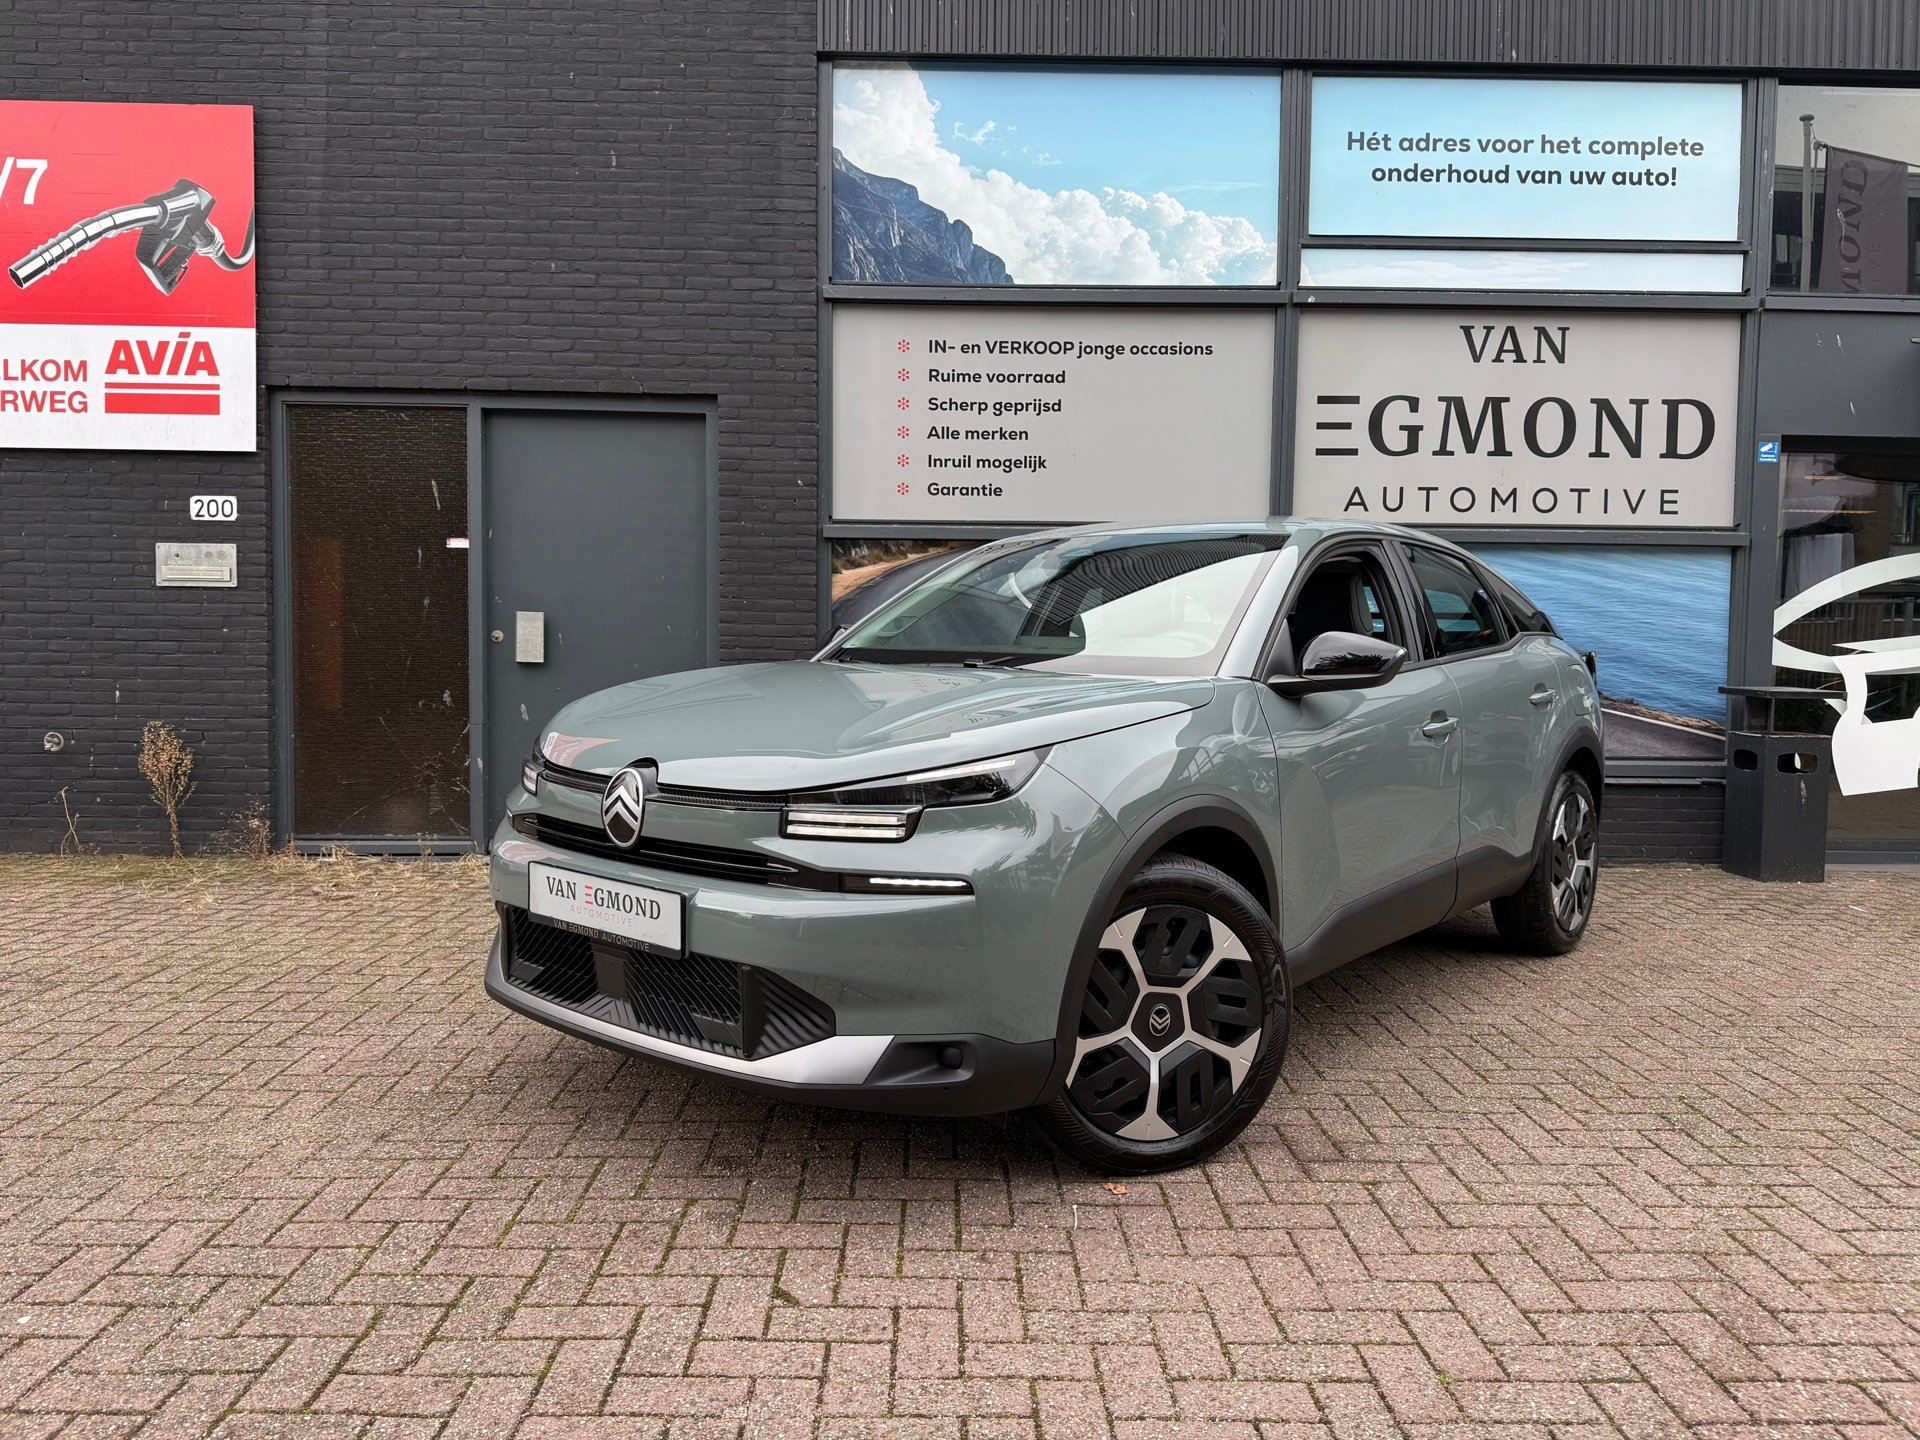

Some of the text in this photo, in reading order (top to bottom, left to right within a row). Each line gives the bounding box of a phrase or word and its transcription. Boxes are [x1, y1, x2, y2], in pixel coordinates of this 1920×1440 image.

[1347, 131, 1704, 161] Hét adres voor het complete
[1371, 163, 1677, 187] onderhoud van uw auto!
[928, 339, 1214, 360] IN- en VERKOOP jonge occasions
[1459, 325, 1570, 364] VAN
[928, 368, 1066, 384] Ruime voorraad
[0, 389, 89, 414] RWEG
[927, 397, 1062, 417] Scherp geprijsd
[926, 425, 1029, 441] Alle merken
[1315, 394, 1716, 460] EGMOND
[928, 454, 1047, 474] Inruil mogelijk
[927, 482, 1003, 497] Garantie
[1343, 486, 1679, 515] AUTOMOTIVE
[193, 498, 234, 519] 200
[546, 875, 661, 920] VAN EGMOND
[570, 904, 633, 928] AUTOMOTIVE
[553, 918, 568, 931] VAN
[602, 934, 650, 952] AUTOMOTIVE
